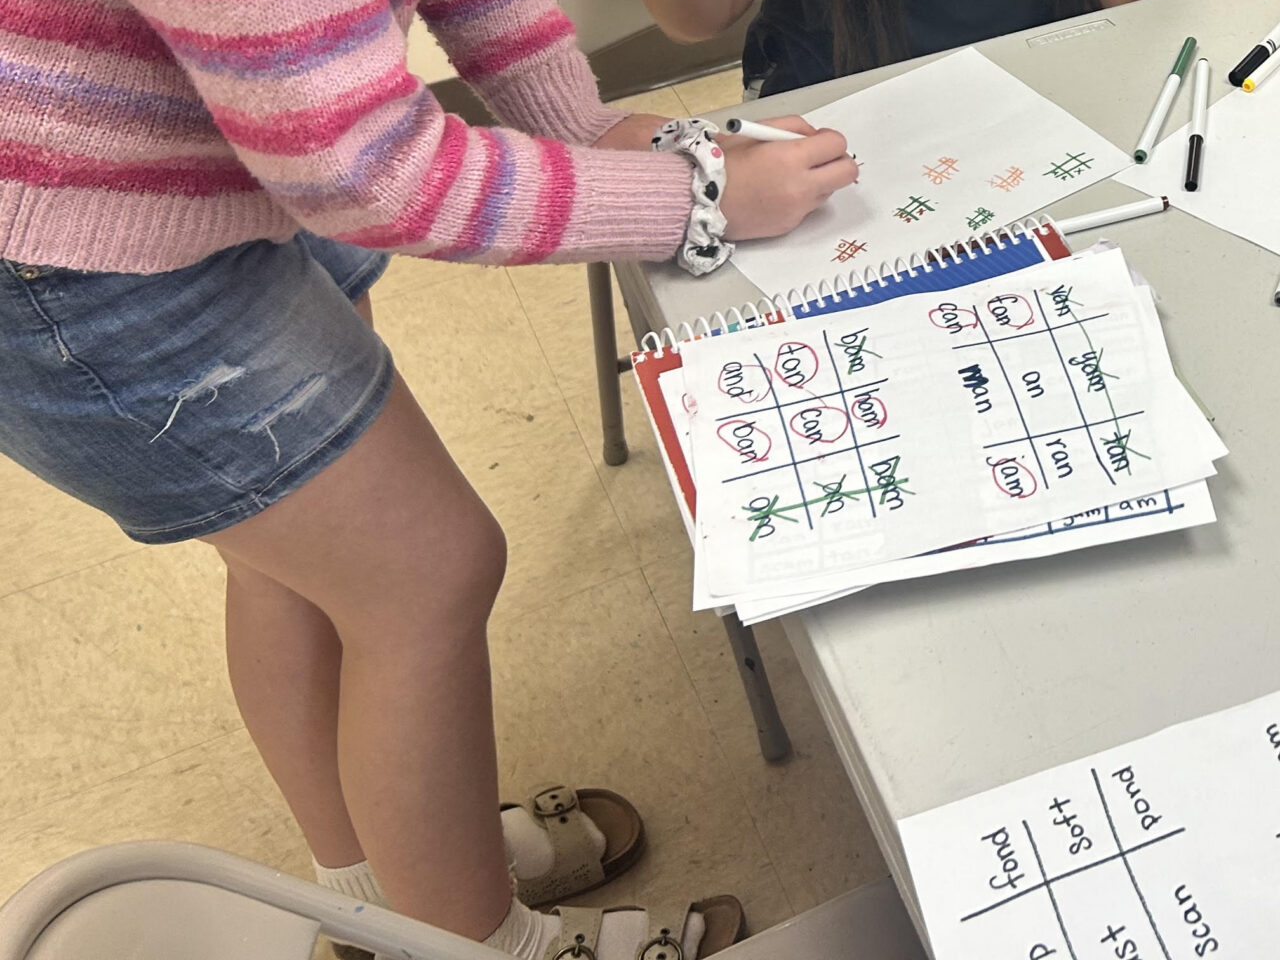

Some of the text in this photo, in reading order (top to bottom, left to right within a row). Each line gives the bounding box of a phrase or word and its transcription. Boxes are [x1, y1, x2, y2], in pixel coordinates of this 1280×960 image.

[939, 303, 963, 334] can
[989, 296, 1017, 326] fan
[723, 361, 753, 398] and
[778, 345, 808, 387] tan
[1022, 371, 1044, 398] an
[855, 388, 880, 428] ham
[733, 422, 757, 463] ban
[1046, 439, 1073, 478] ran
[986, 455, 1024, 498] jam
[1119, 497, 1157, 510] am
[1111, 765, 1163, 831] pond
[1048, 797, 1093, 856] soft
[980, 826, 1026, 891] fond
[1174, 884, 1219, 958] scan
